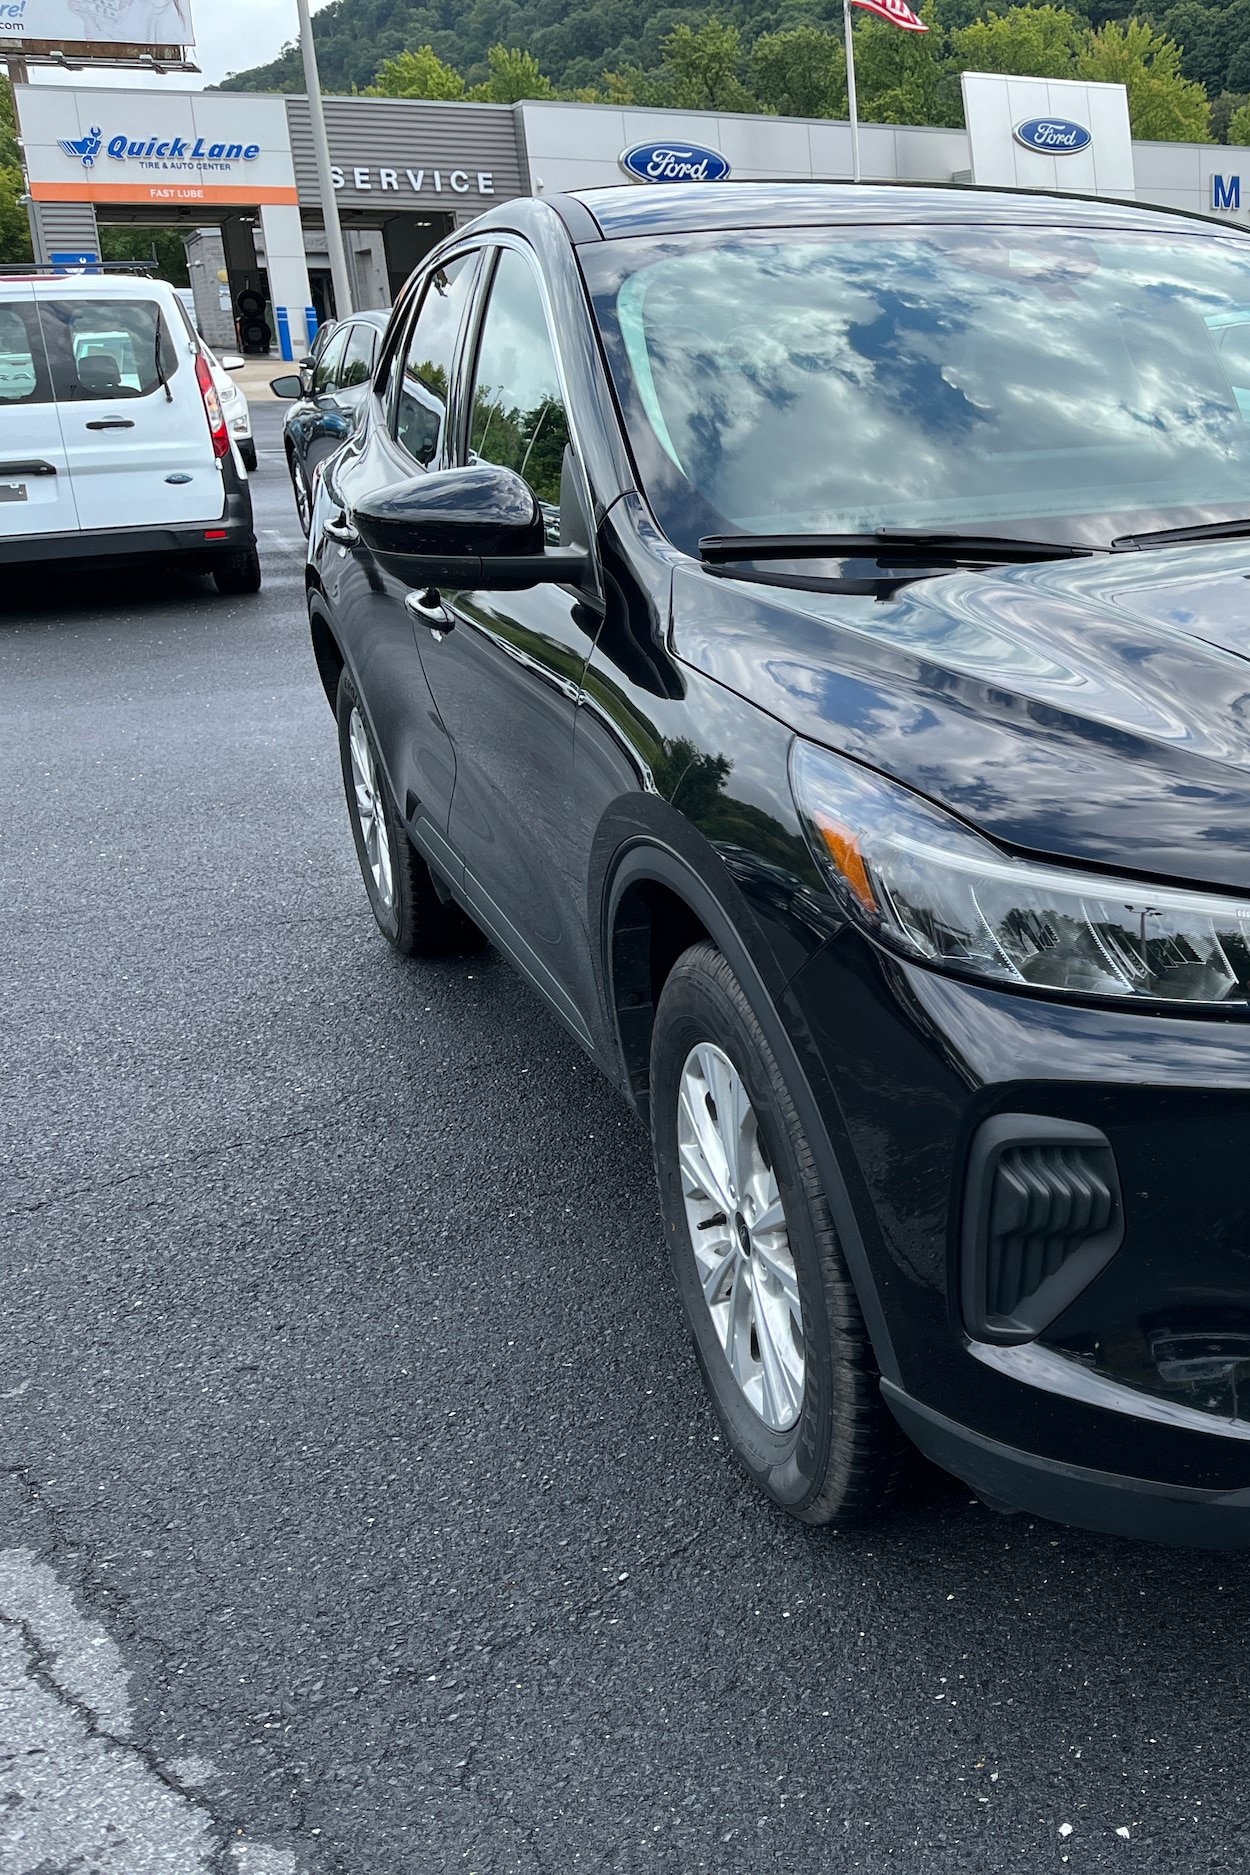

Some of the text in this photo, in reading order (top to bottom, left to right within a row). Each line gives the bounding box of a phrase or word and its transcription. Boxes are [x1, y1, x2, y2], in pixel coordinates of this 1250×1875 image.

[1034, 123, 1077, 145] Ford
[107, 135, 260, 159] Quick Lane
[170, 162, 194, 170] AUTO
[646, 149, 709, 181] Ford
[330, 165, 495, 195] SERVICE
[150, 188, 204, 198] FAST LUBE
